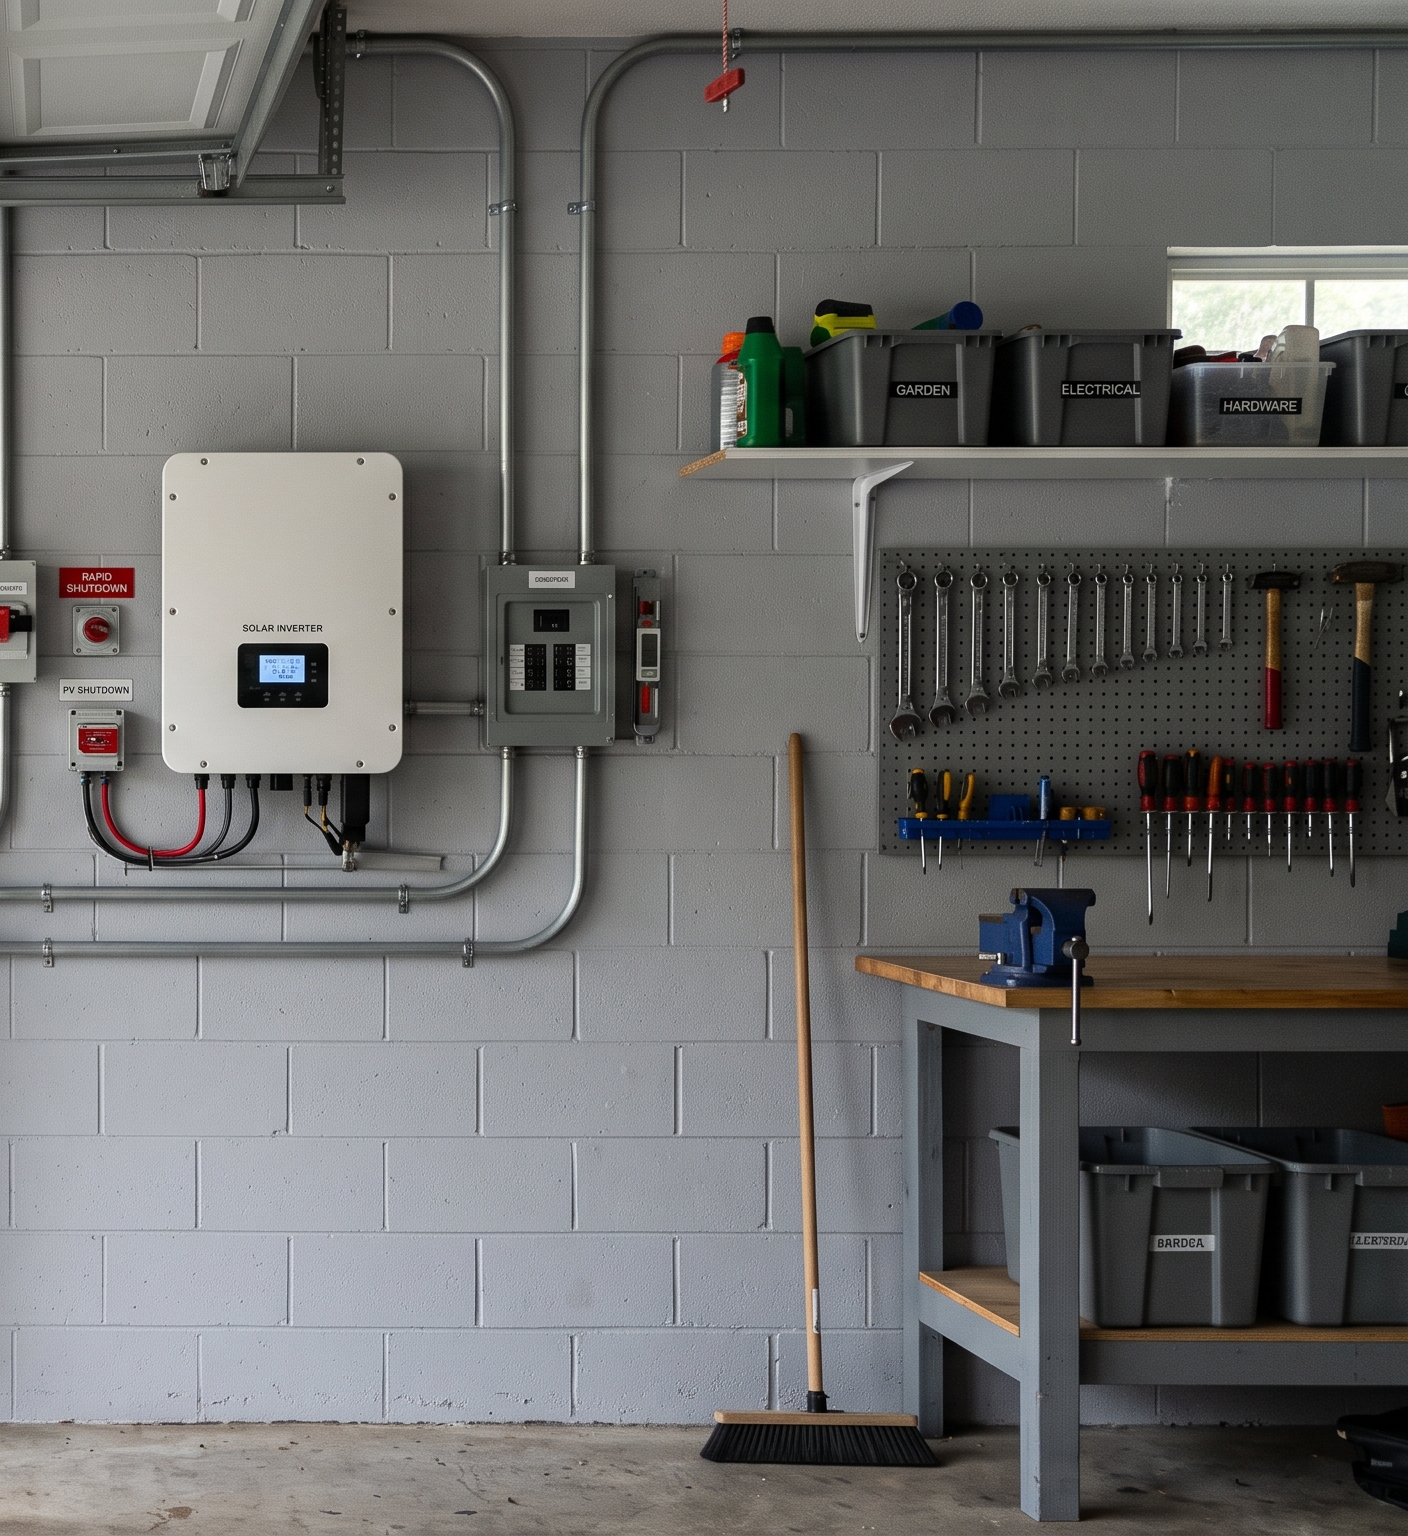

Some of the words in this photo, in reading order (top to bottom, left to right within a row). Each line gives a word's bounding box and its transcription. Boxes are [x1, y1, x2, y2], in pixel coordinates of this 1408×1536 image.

[896, 384, 951, 396] GARDEN
[1061, 383, 1141, 396] ELECTRICAL
[1223, 400, 1298, 412] HARDWARE
[82, 572, 113, 582] RAPID
[242, 624, 275, 633] SOLAR
[276, 624, 323, 633] INVERTER
[62, 686, 75, 695] PV
[77, 685, 130, 695] SHUTDOWN
